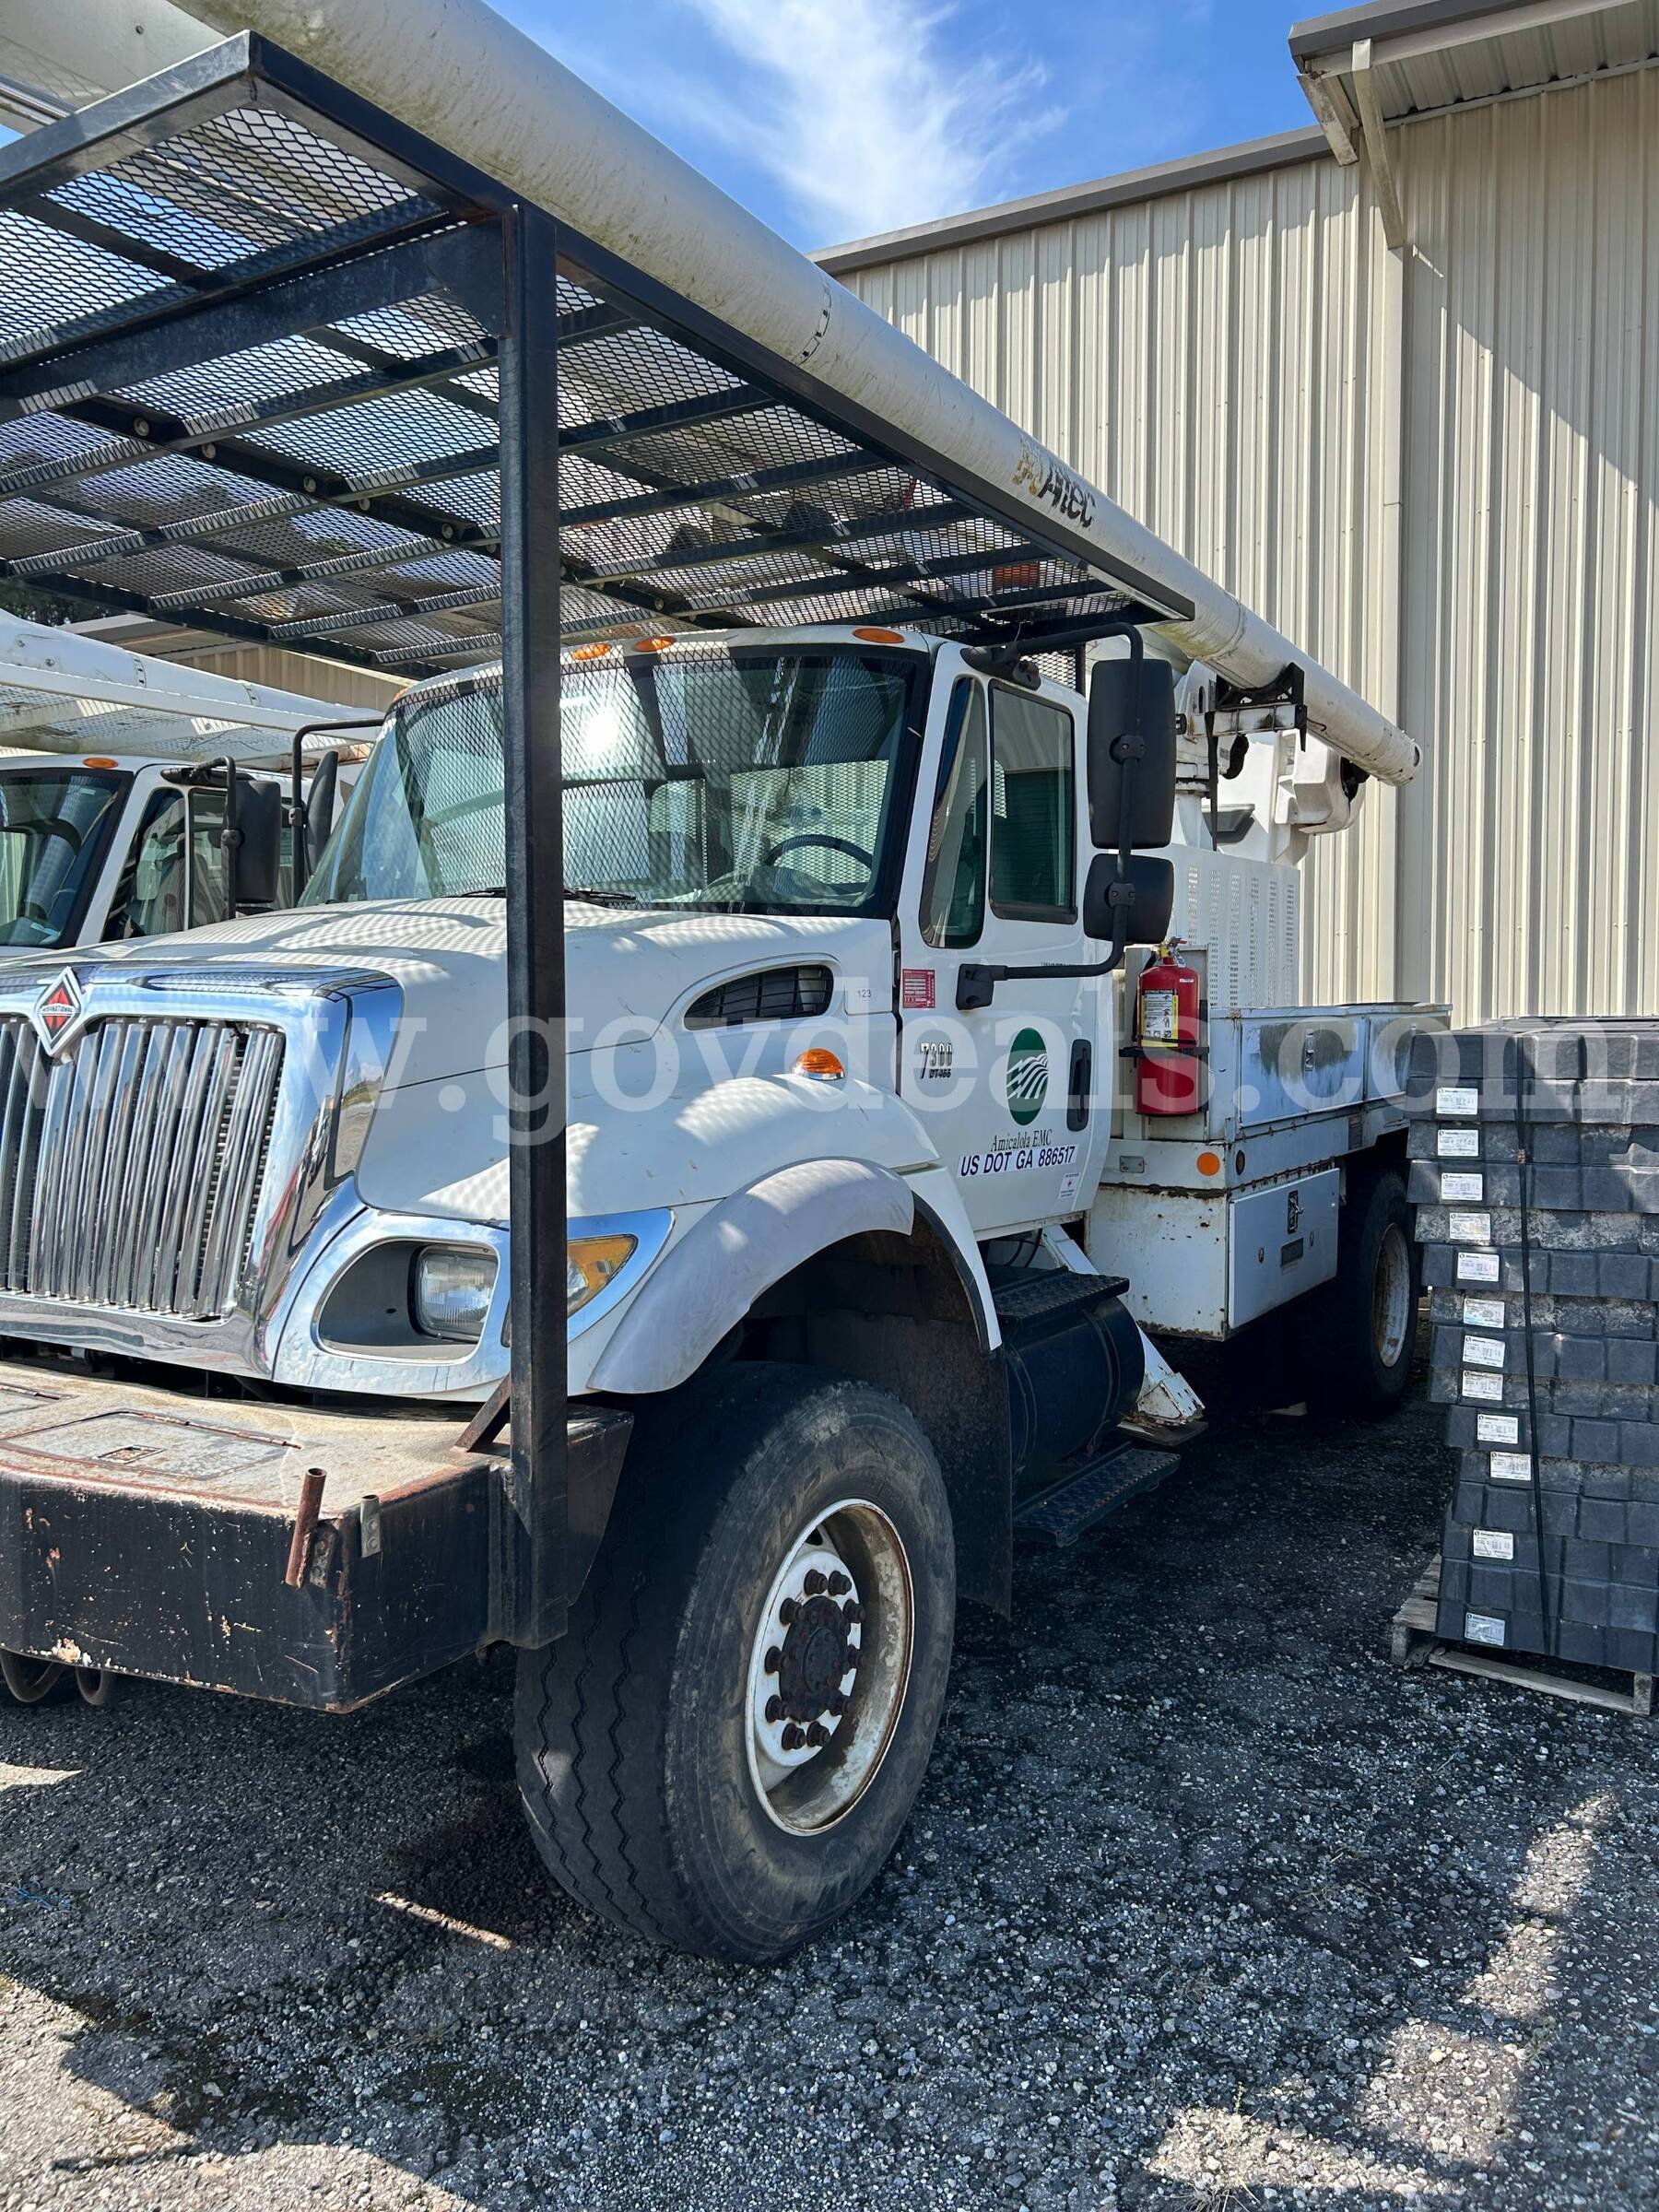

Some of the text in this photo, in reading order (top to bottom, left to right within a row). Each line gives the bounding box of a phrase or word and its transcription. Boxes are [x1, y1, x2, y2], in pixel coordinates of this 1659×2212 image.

[857, 989, 871, 998] 123
[920, 1042, 953, 1078] 7300
[990, 1128, 1053, 1152] Amicalola EMC
[960, 1146, 1076, 1177] US DOT GA 886517
